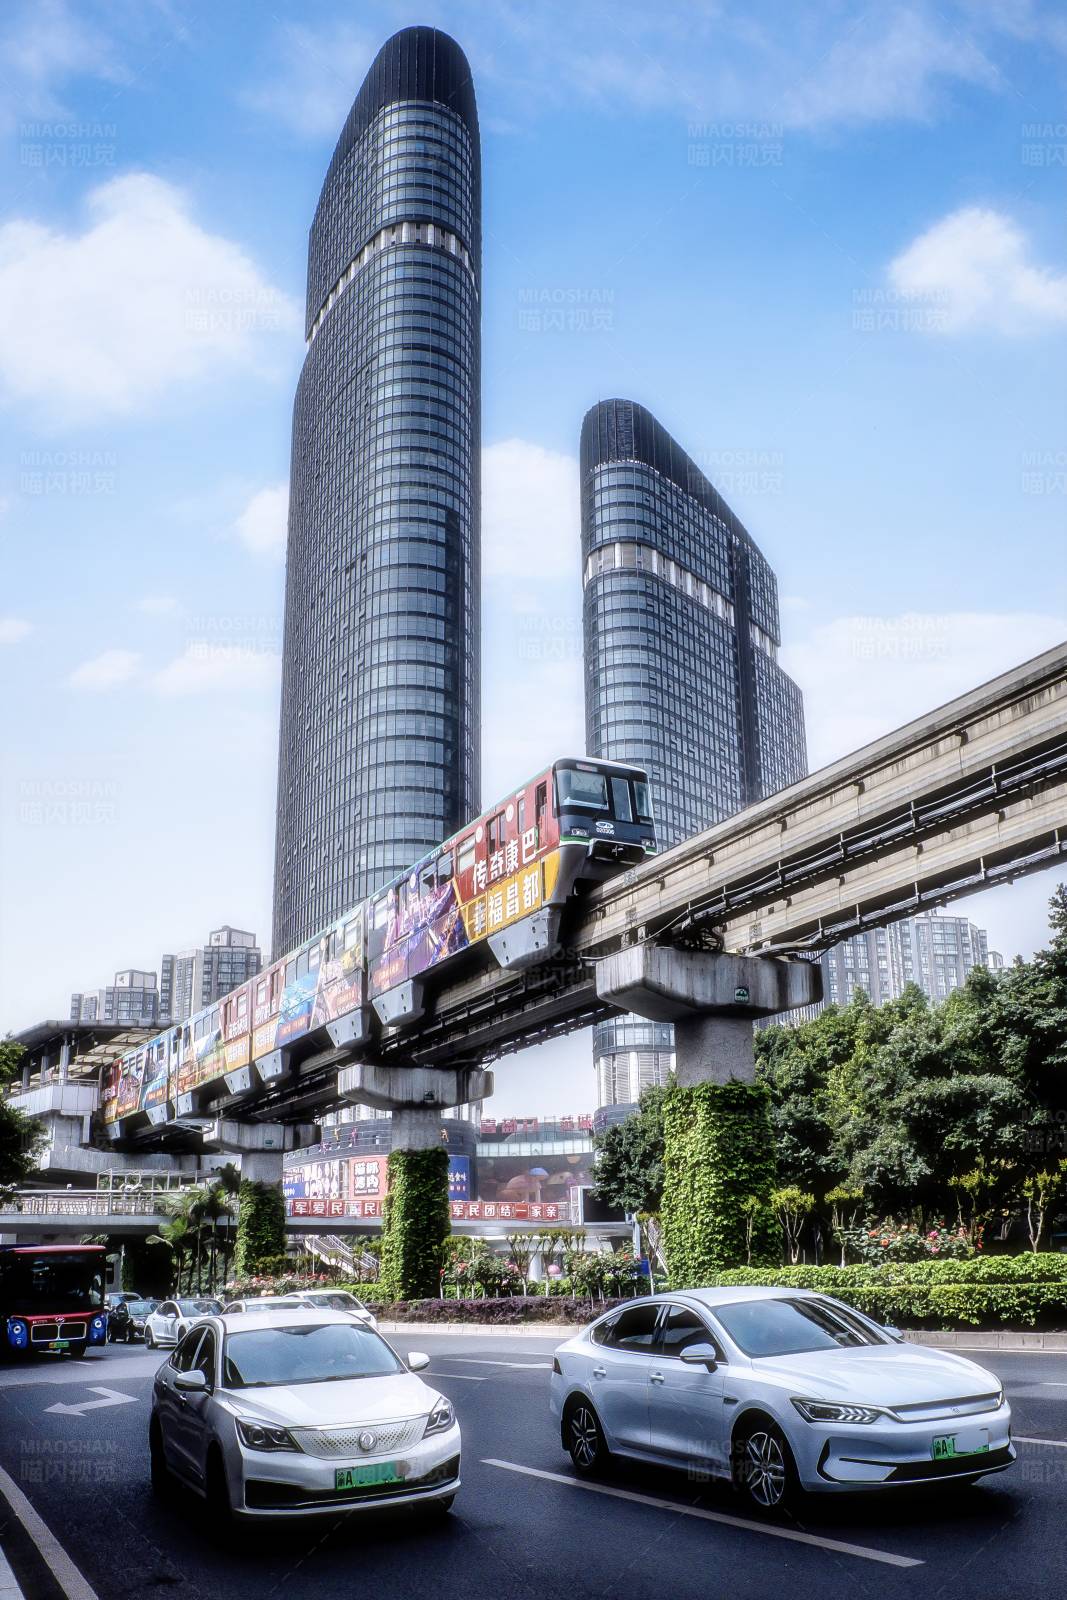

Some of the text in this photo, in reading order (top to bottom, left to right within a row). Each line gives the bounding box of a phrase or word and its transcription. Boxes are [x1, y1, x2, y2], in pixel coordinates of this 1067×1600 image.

[473, 827, 535, 895] 传奇康巴
[474, 870, 539, 934] 幸福昌都
[452, 1204, 558, 1218] 军民团结一家亲
